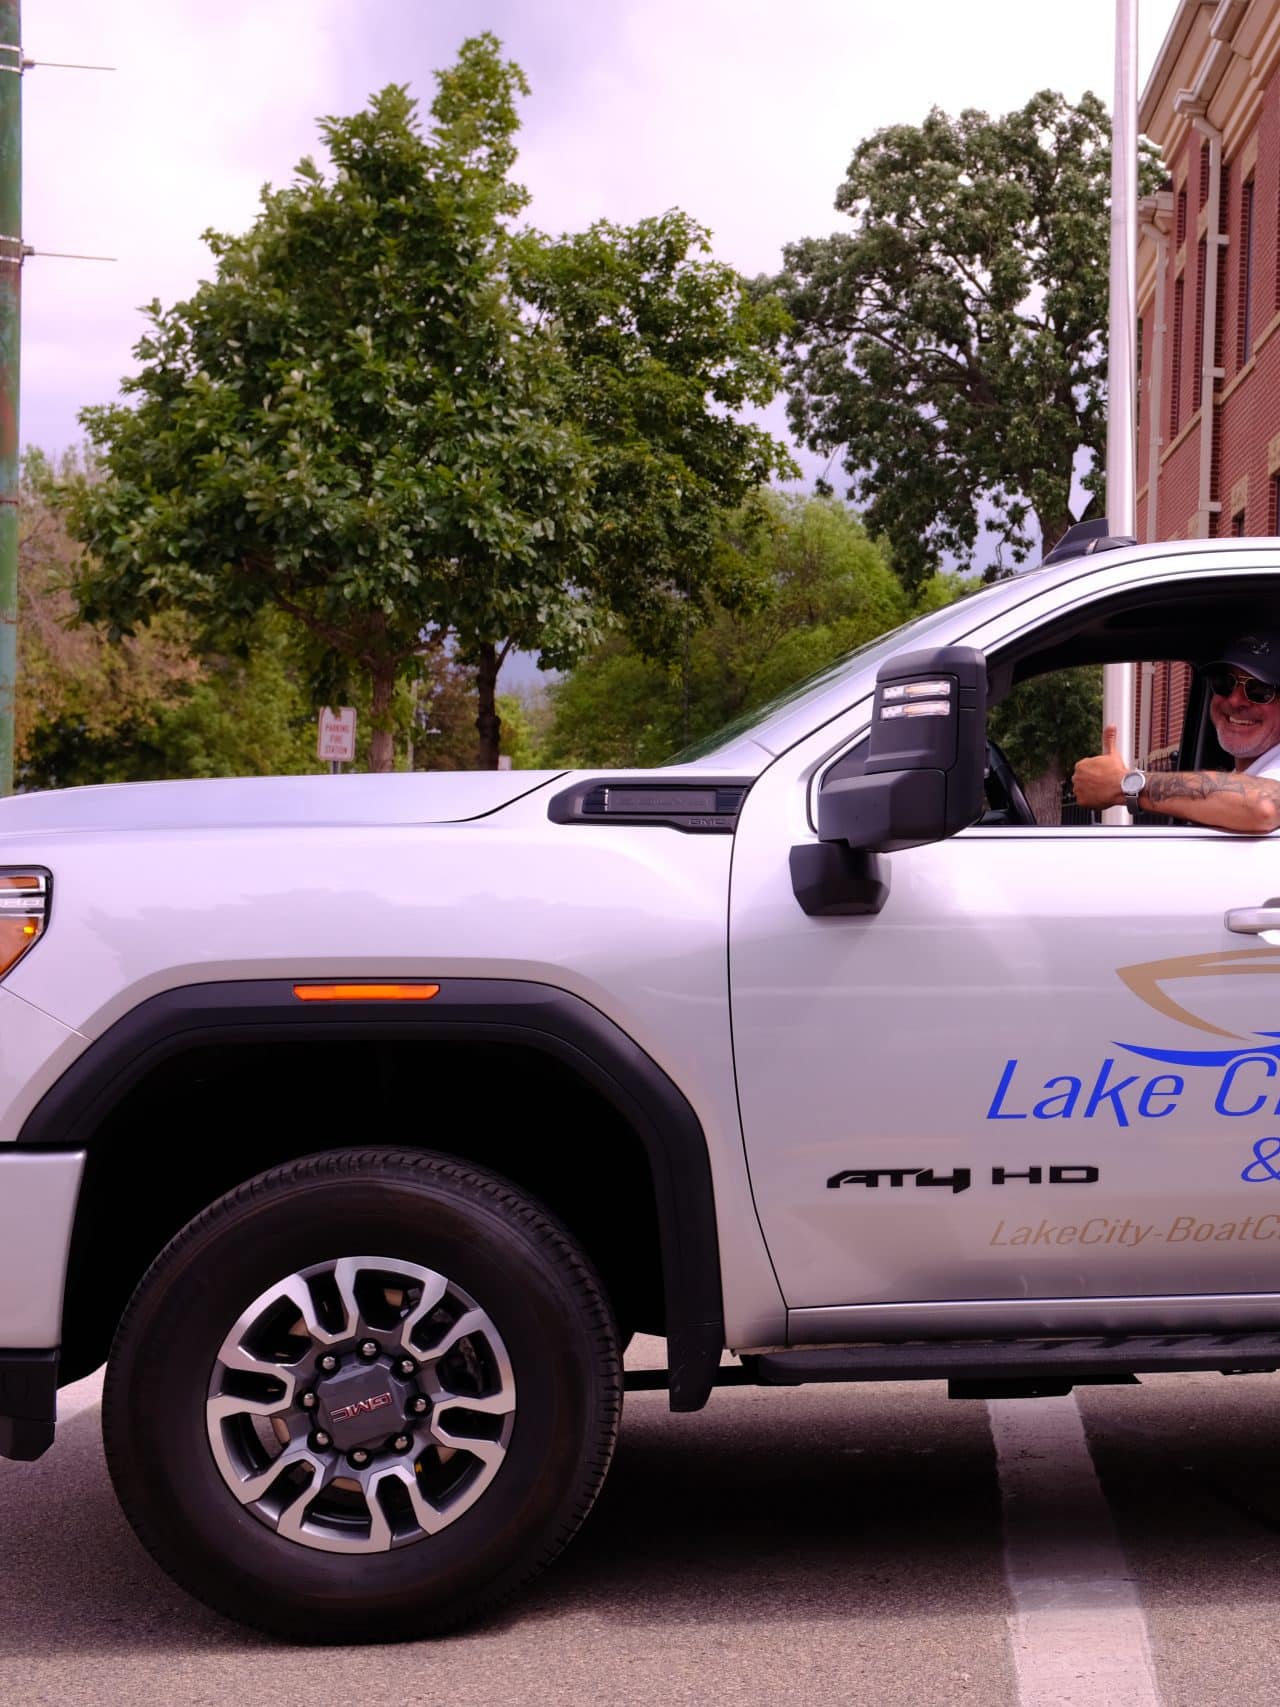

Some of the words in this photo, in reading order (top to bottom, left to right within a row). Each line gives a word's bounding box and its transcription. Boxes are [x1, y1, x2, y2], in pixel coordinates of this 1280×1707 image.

[987, 1058, 1184, 1128] Lake
[991, 1165, 1099, 1185] HD
[329, 1392, 393, 1424] GMC
